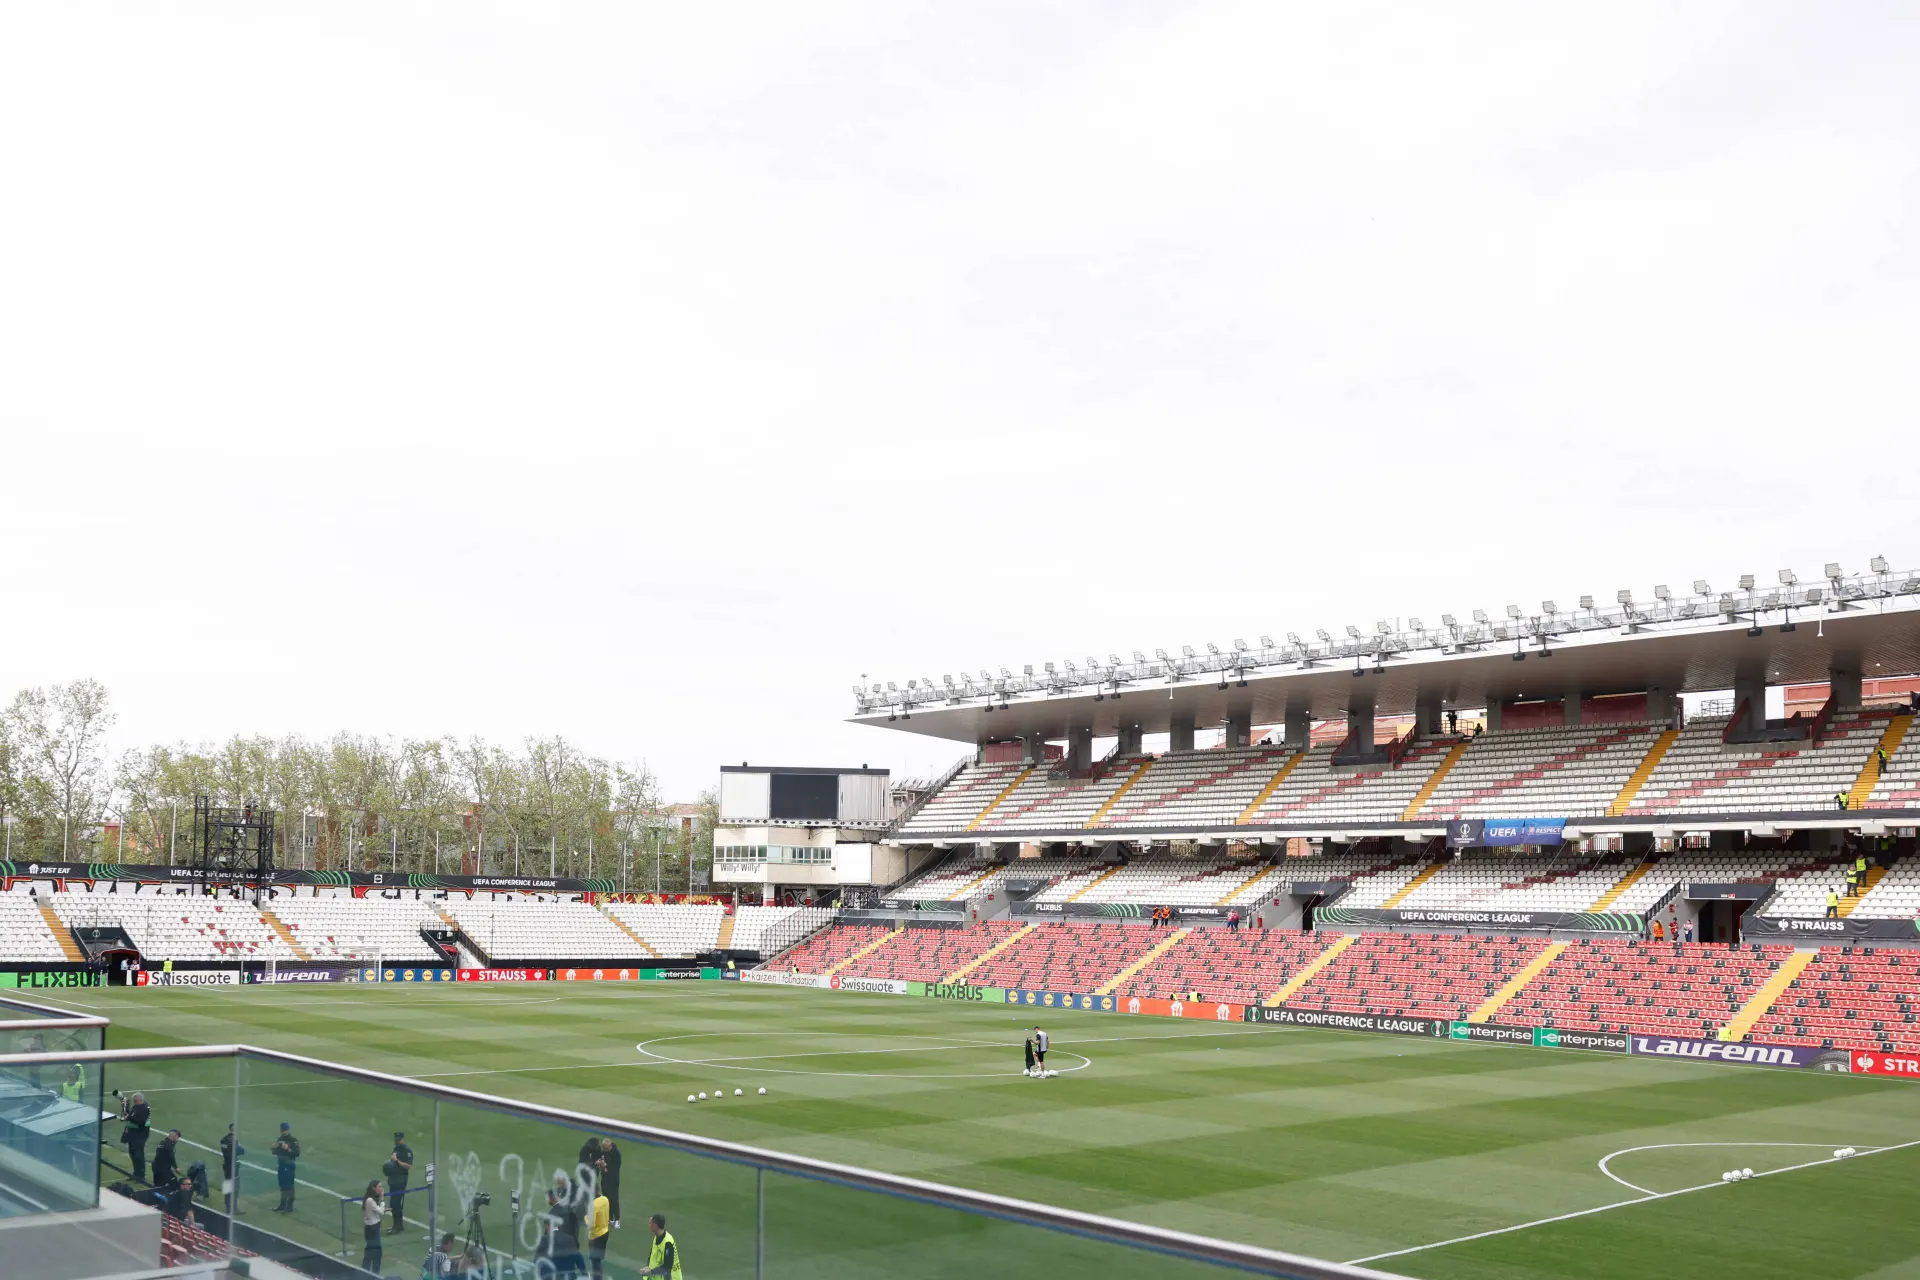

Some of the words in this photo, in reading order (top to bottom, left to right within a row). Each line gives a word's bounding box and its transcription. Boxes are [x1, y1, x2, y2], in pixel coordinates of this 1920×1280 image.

[1490, 828, 1517, 837] UEFA
[171, 869, 191, 877] UEFA
[491, 879, 530, 887] CONFERENCE
[1400, 911, 1425, 920] UEFA
[1427, 912, 1489, 922] CONFERENCE
[1492, 914, 1530, 923] LEAGUE
[1791, 921, 1844, 930] STRAUSS
[478, 970, 527, 980] STRAUSS
[658, 970, 700, 979] enterprise
[752, 971, 777, 982] kaizen
[841, 977, 894, 992] Swissquote
[1265, 1010, 1294, 1022] UEFA
[1296, 1012, 1374, 1028] CONFERENCE
[1377, 1019, 1425, 1033] LEAGUE
[1457, 1026, 1532, 1040] enterprise
[1545, 1033, 1626, 1048] enterprise
[1634, 1037, 1800, 1065] Laufenn
[1884, 1058, 1920, 1073] STR
